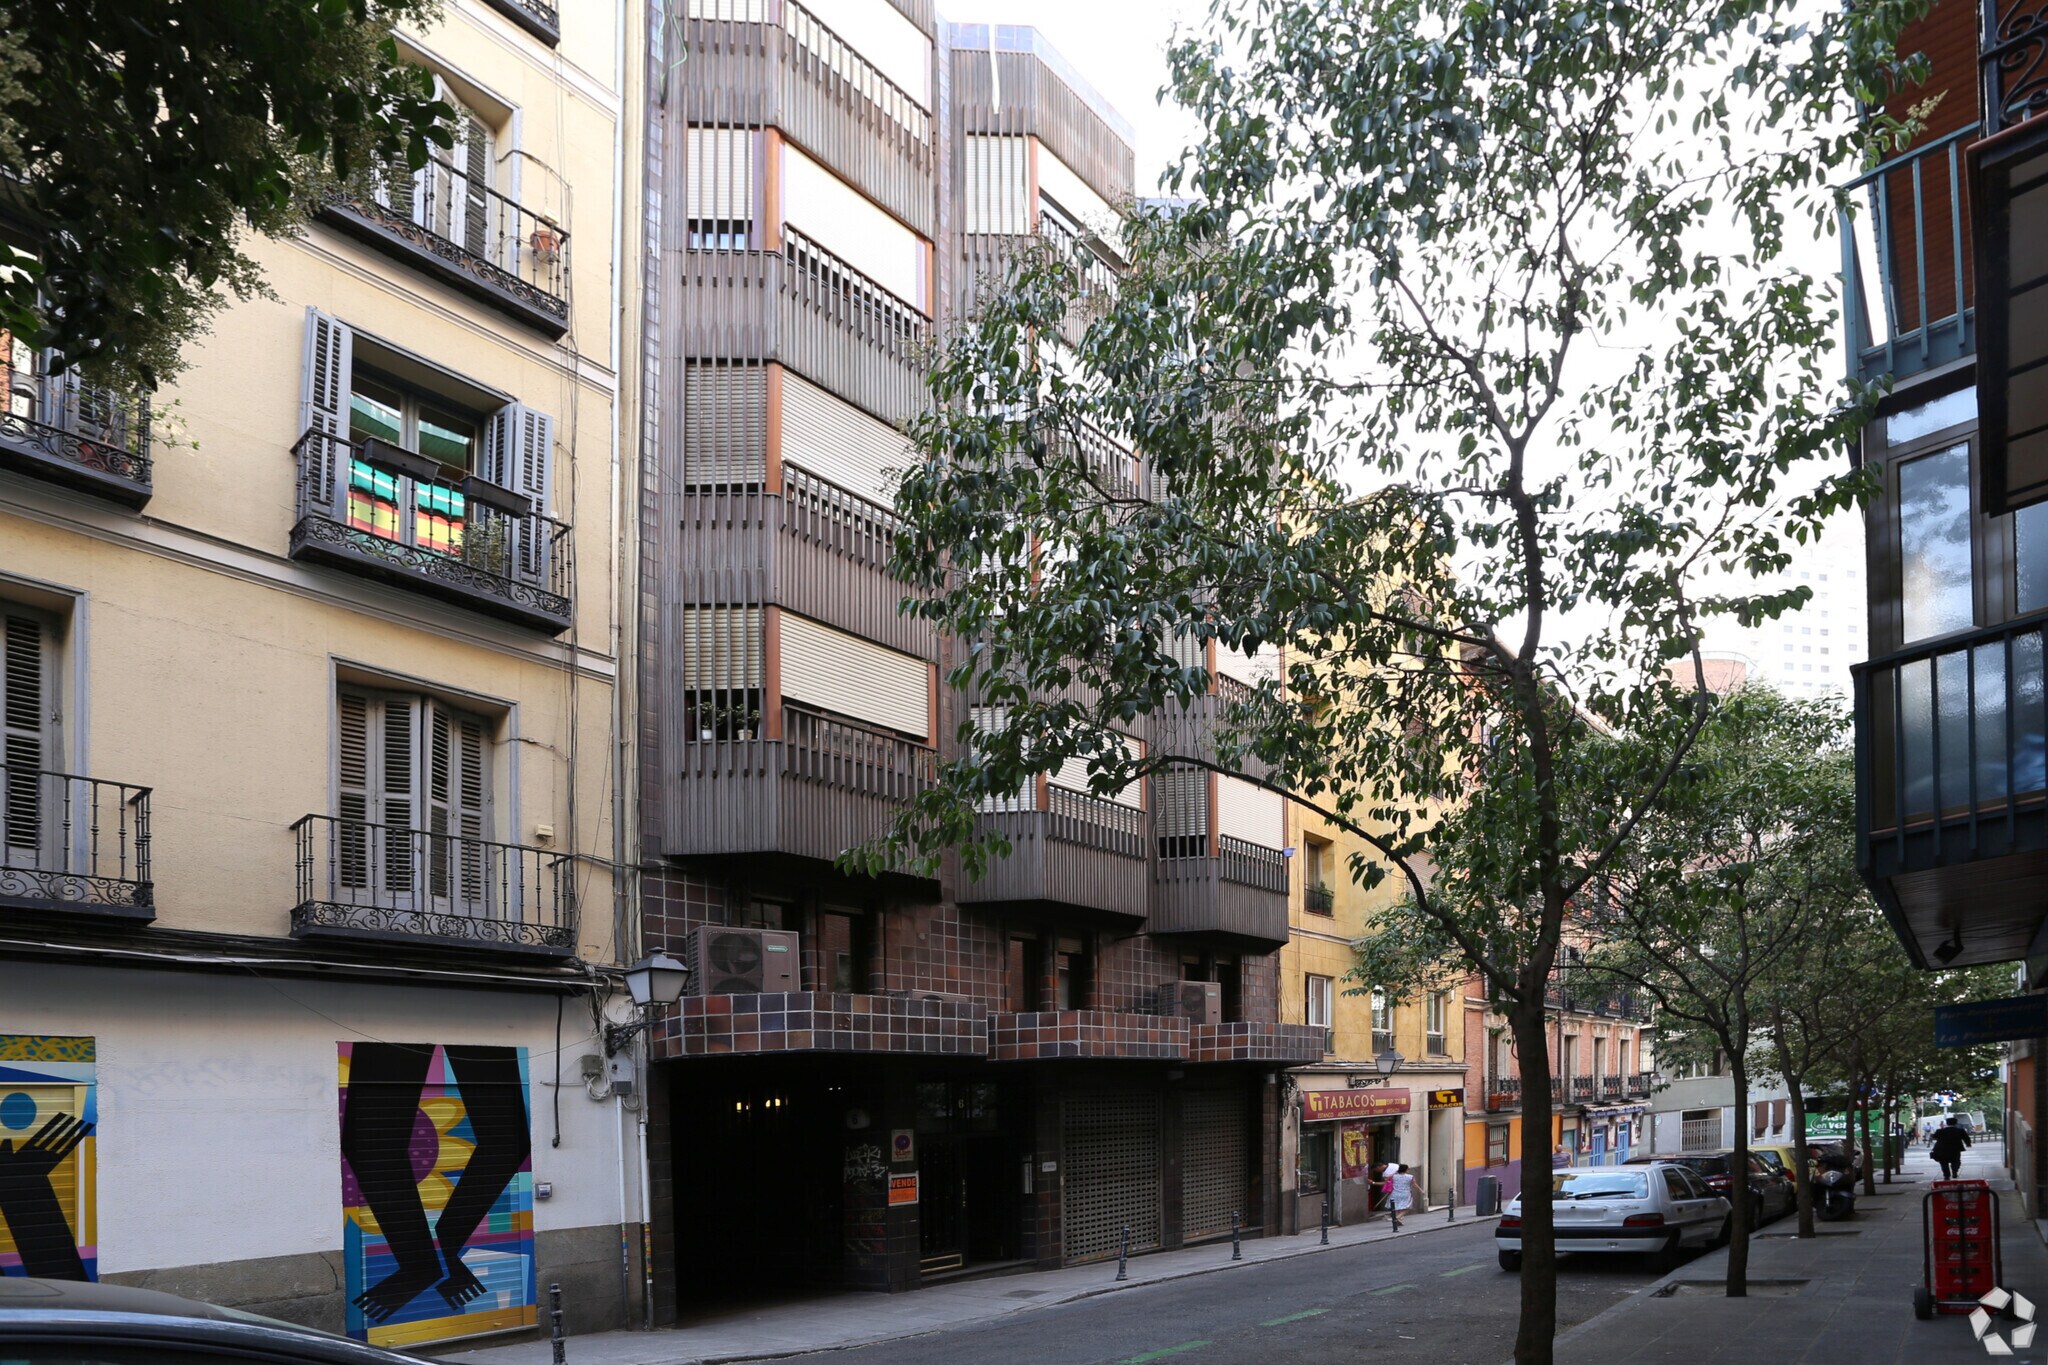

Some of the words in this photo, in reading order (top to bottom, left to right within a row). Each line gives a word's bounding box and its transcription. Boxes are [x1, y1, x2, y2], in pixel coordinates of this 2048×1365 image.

[958, 1099, 965, 1109] 6
[1324, 1094, 1376, 1110] TABACOS
[891, 1177, 916, 1188] VENDE
